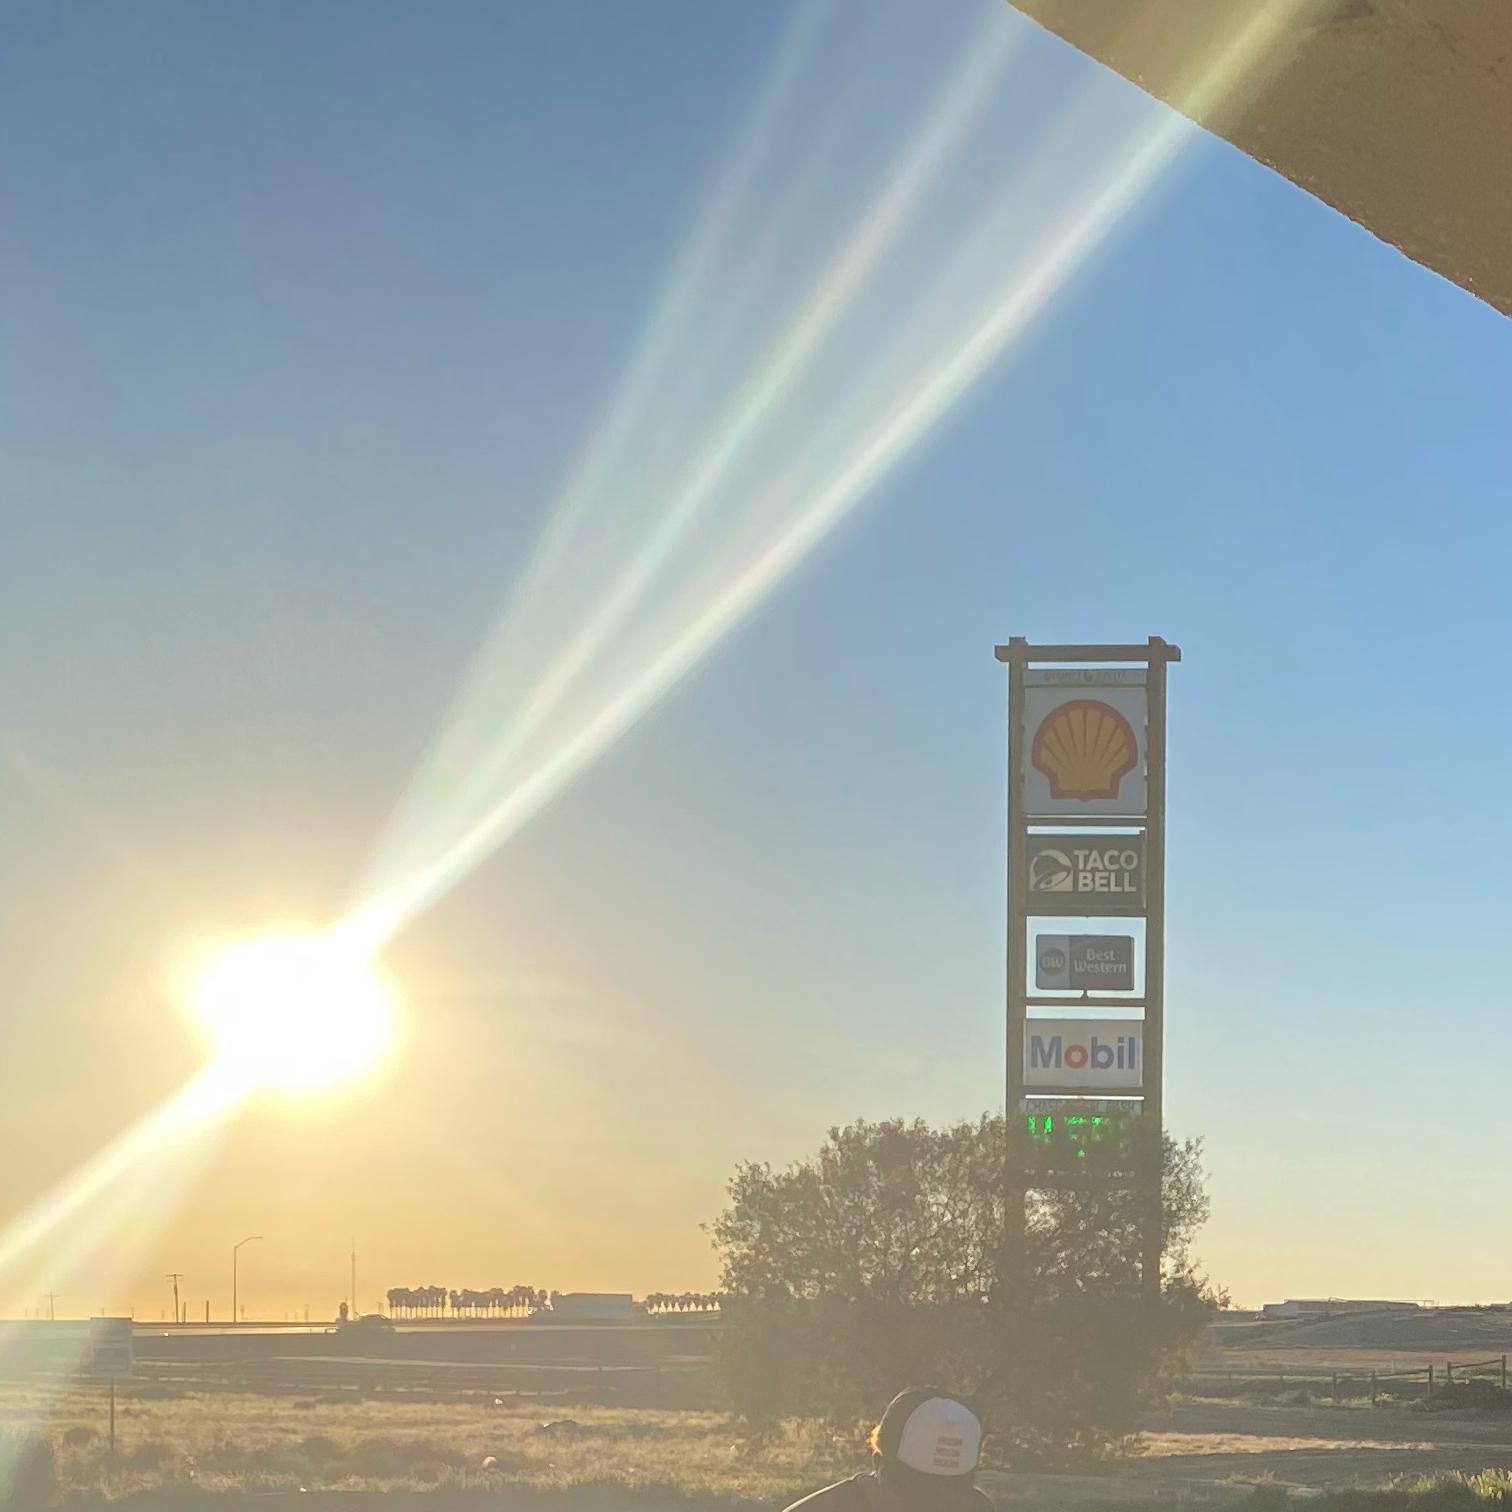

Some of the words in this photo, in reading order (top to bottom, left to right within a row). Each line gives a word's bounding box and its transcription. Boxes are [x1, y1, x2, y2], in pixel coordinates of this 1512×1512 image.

[1074, 849, 1138, 870] TACO
[1078, 872, 1137, 892] BELL
[1086, 948, 1116, 961] Best
[1074, 960, 1128, 973] Western
[1031, 1035, 1136, 1070] Mobil
